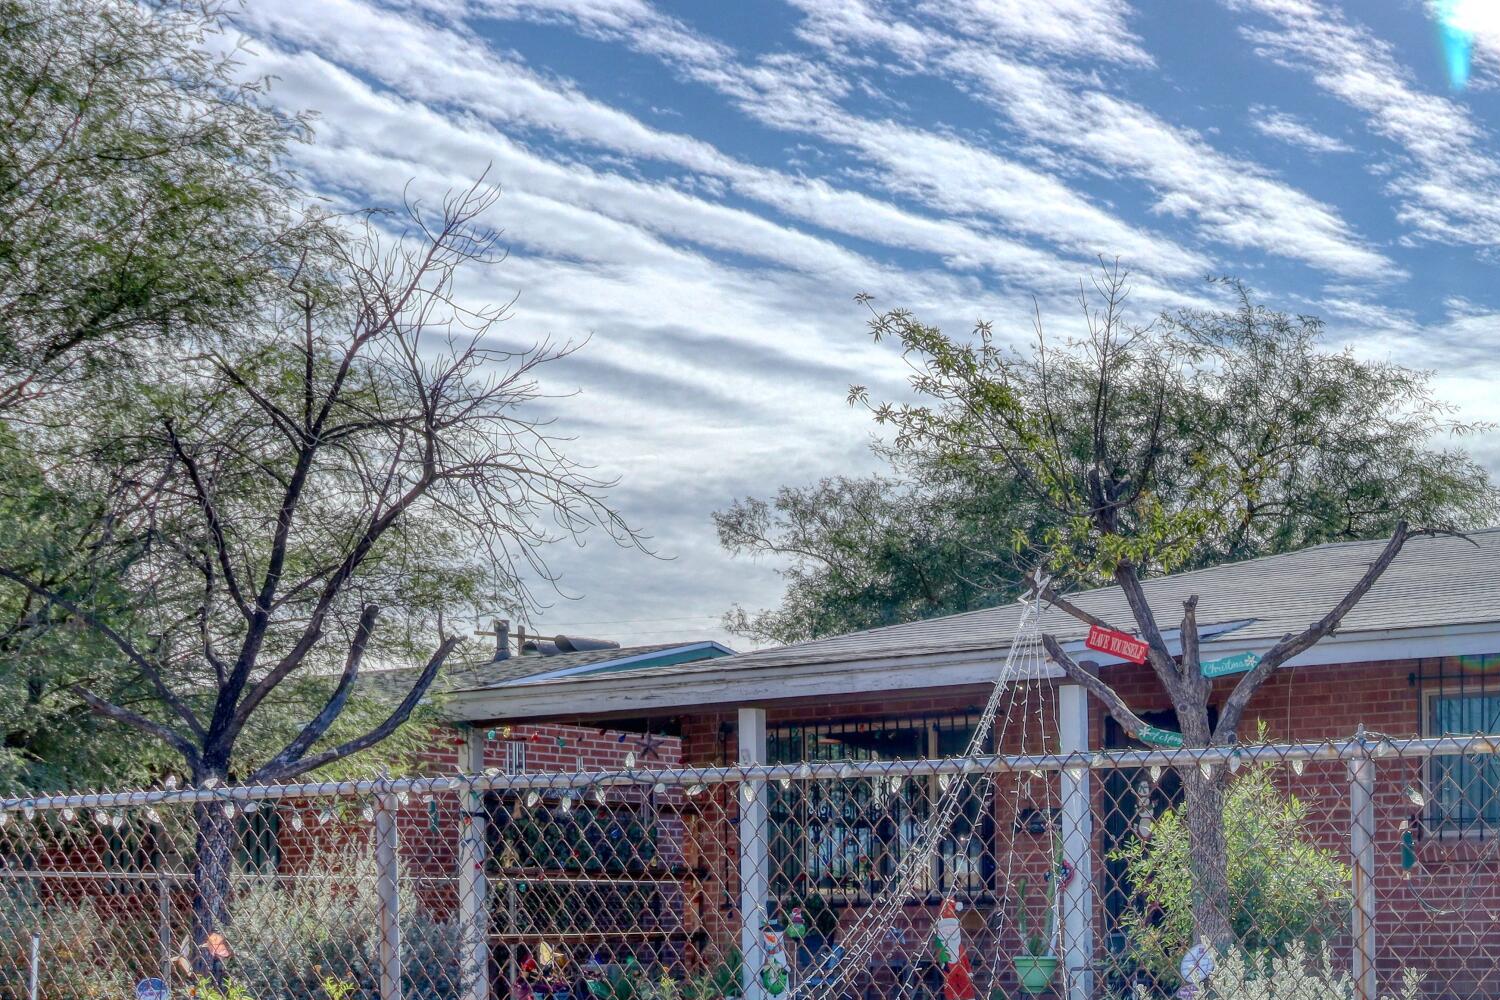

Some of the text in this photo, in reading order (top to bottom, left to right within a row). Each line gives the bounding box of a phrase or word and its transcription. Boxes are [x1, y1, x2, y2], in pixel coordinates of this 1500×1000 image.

[1090, 630, 1145, 659] HAVE YOURSELF
[1203, 659, 1247, 675] Christma
